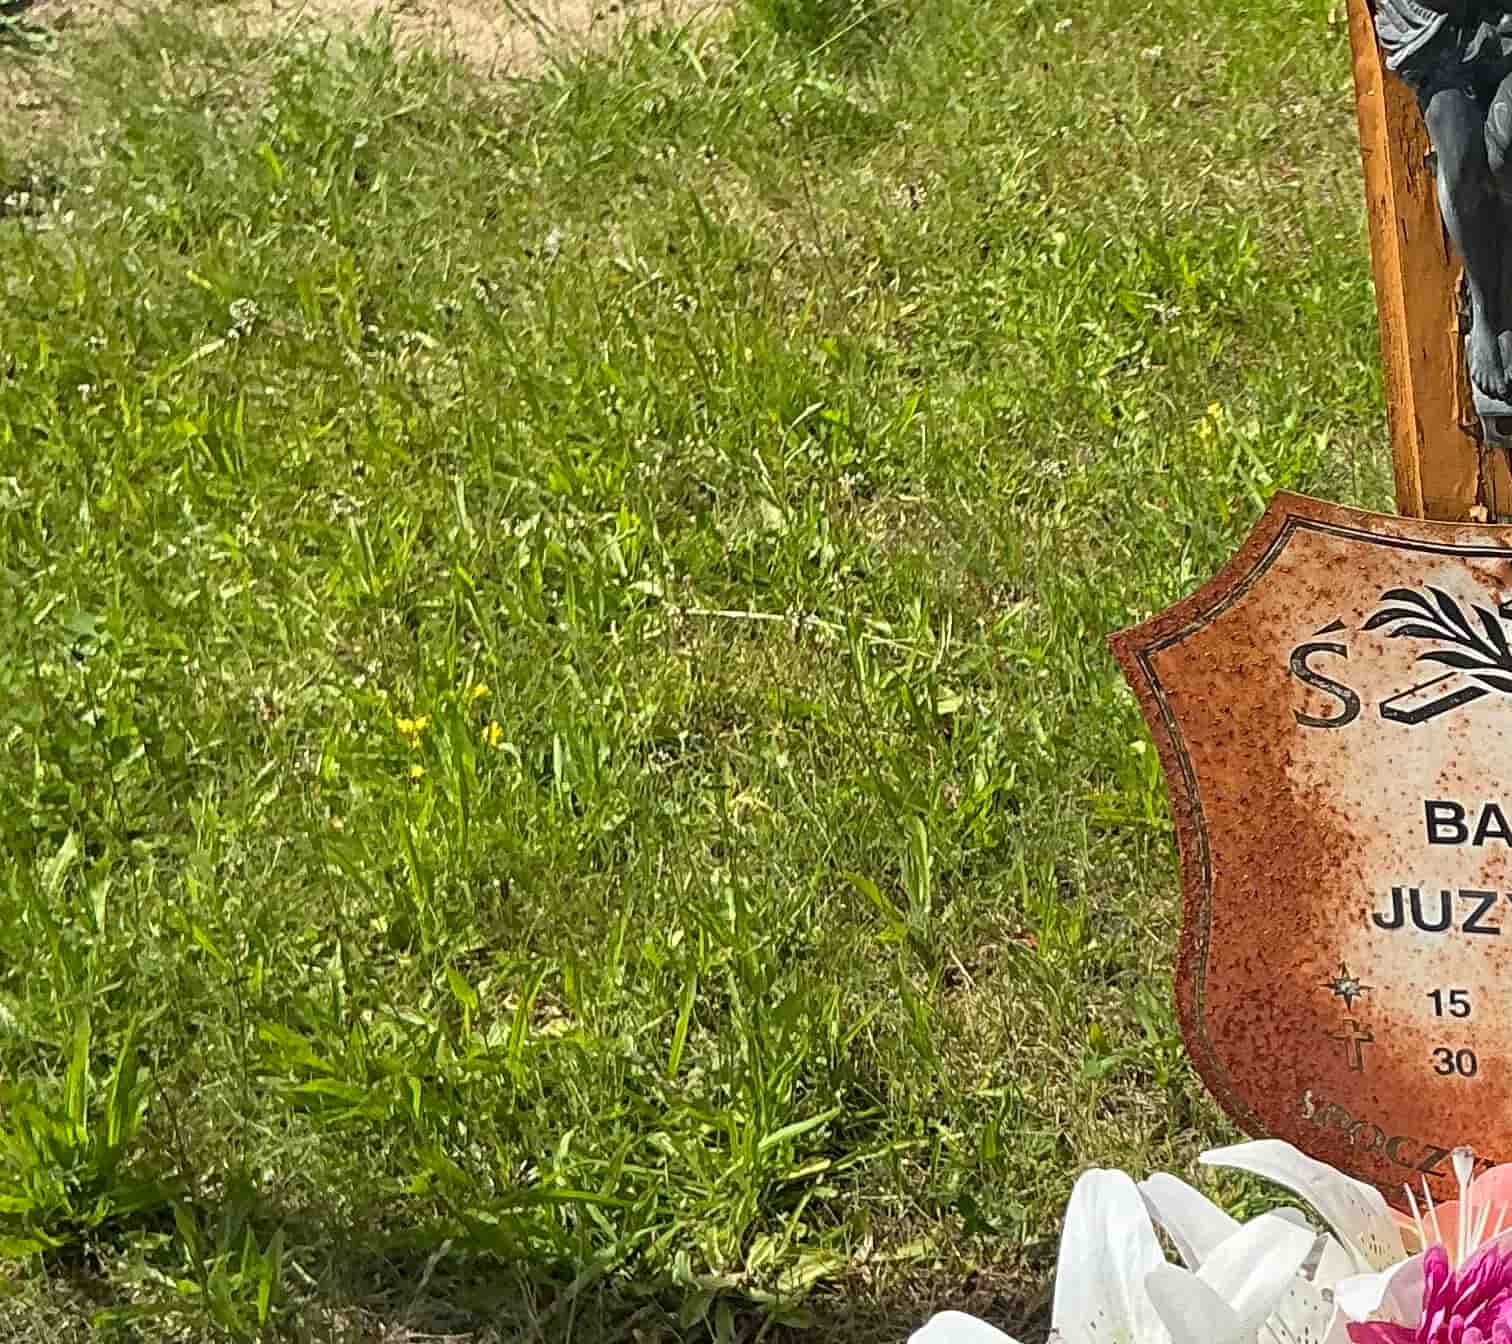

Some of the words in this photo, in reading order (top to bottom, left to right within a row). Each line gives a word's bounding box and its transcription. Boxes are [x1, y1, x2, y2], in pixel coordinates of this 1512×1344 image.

[1289, 619, 1361, 728] Ś
[1427, 988, 1471, 1018] 15
[1432, 1047, 1478, 1078] 30
